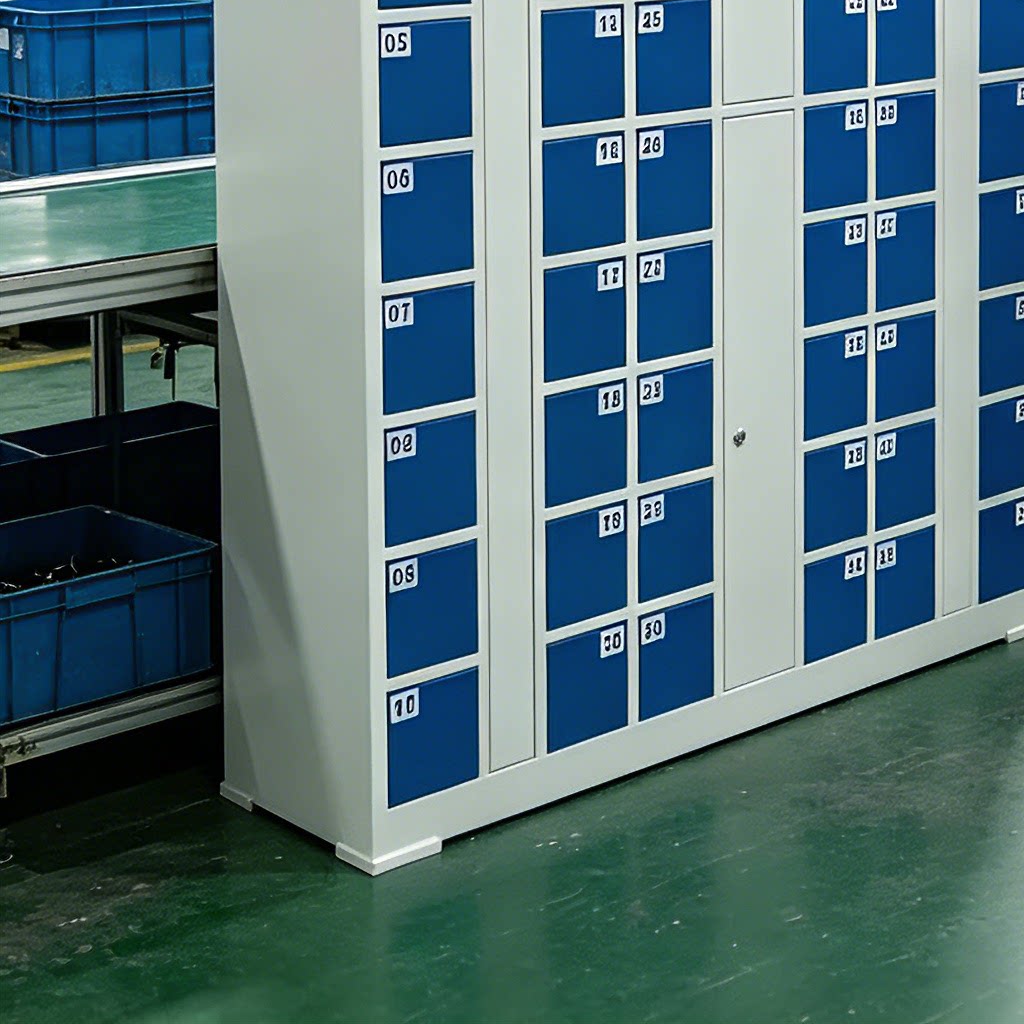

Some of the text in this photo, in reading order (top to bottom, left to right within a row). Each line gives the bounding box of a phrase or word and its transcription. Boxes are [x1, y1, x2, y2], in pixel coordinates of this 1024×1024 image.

[385, 32, 407, 53] 05
[387, 169, 410, 189] 06
[389, 303, 410, 322] 07
